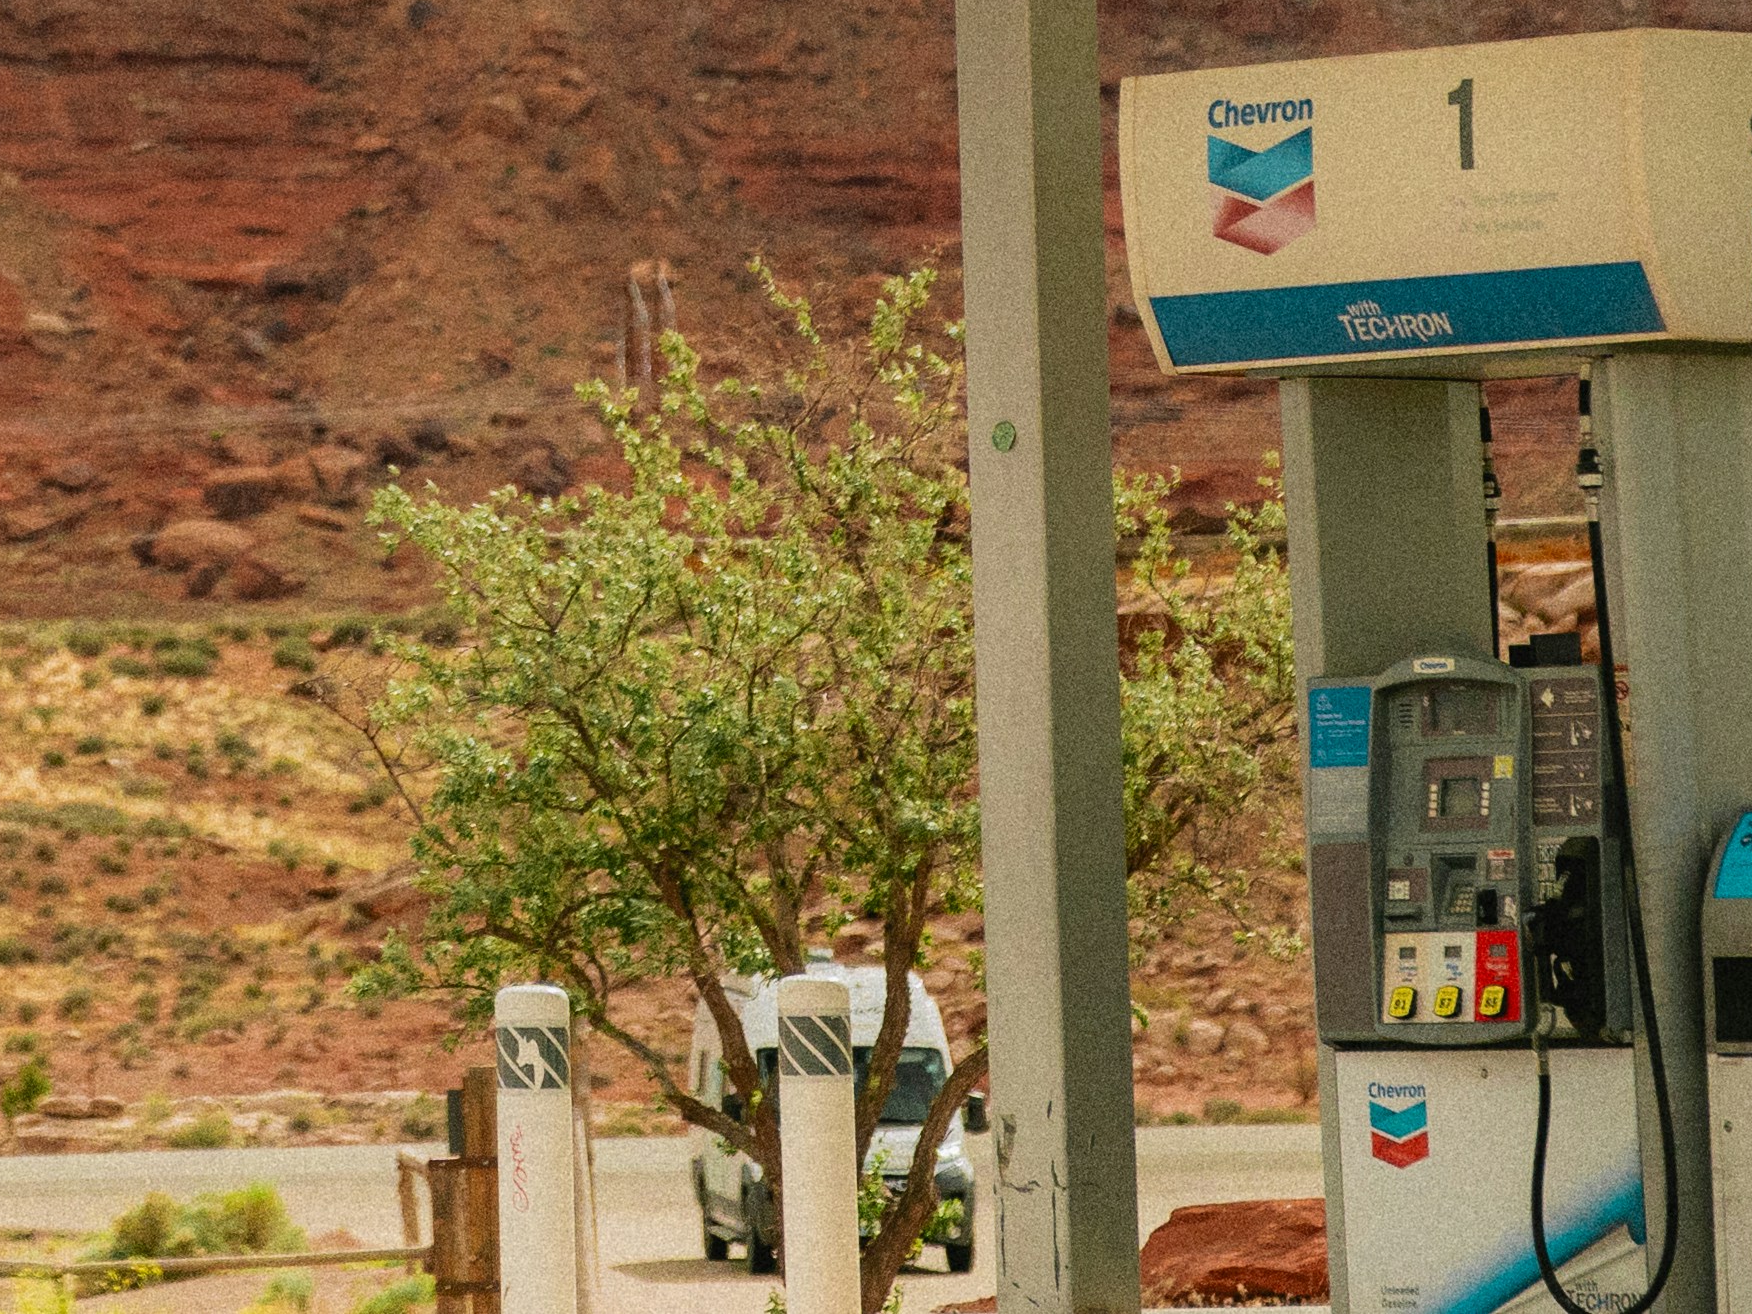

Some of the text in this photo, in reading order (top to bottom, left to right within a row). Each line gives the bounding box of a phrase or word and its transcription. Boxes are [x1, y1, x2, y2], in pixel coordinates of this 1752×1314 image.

[1208, 98, 1313, 128] Chevron
[1448, 78, 1474, 170] 1
[1345, 300, 1381, 317] with
[1337, 313, 1454, 342] TECHRON
[1368, 1082, 1427, 1099] Chevron
